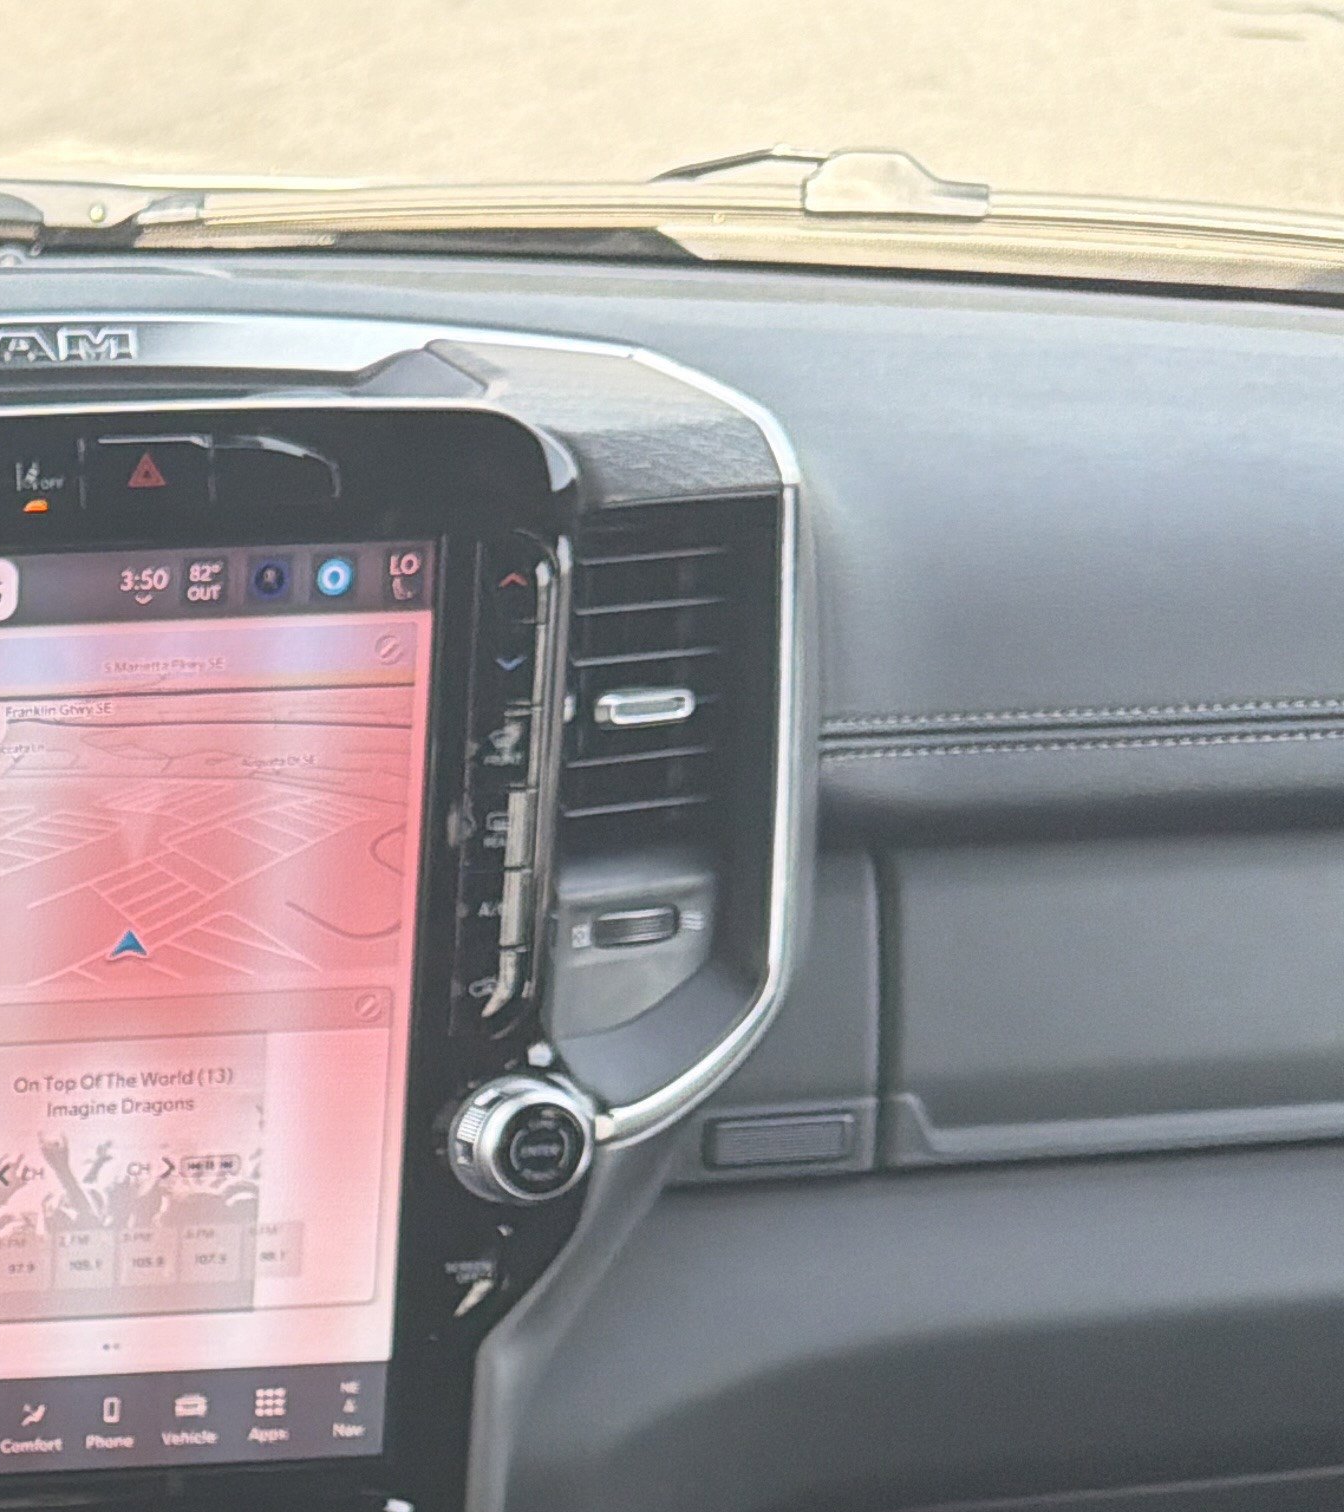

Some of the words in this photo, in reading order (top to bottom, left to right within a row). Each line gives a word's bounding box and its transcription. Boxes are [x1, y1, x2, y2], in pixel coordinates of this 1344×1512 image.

[390, 554, 420, 576] LO
[119, 567, 170, 592] 3:50
[187, 585, 221, 601] OUT
[5, 704, 56, 718] Franklin
[96, 702, 112, 714] SE
[13, 1076, 40, 1093] On
[43, 1075, 77, 1094] Top
[80, 1073, 105, 1090] Of
[106, 1072, 137, 1088] The
[140, 1069, 194, 1088] World
[197, 1067, 234, 1087] (13)
[47, 1101, 117, 1120] Imagine
[121, 1098, 195, 1117] Dragons
[85, 1433, 135, 1449] Phone
[162, 1430, 218, 1447] Vehicle
[247, 1426, 290, 1443] Apps
[0, 1436, 63, 1454] Comfort
